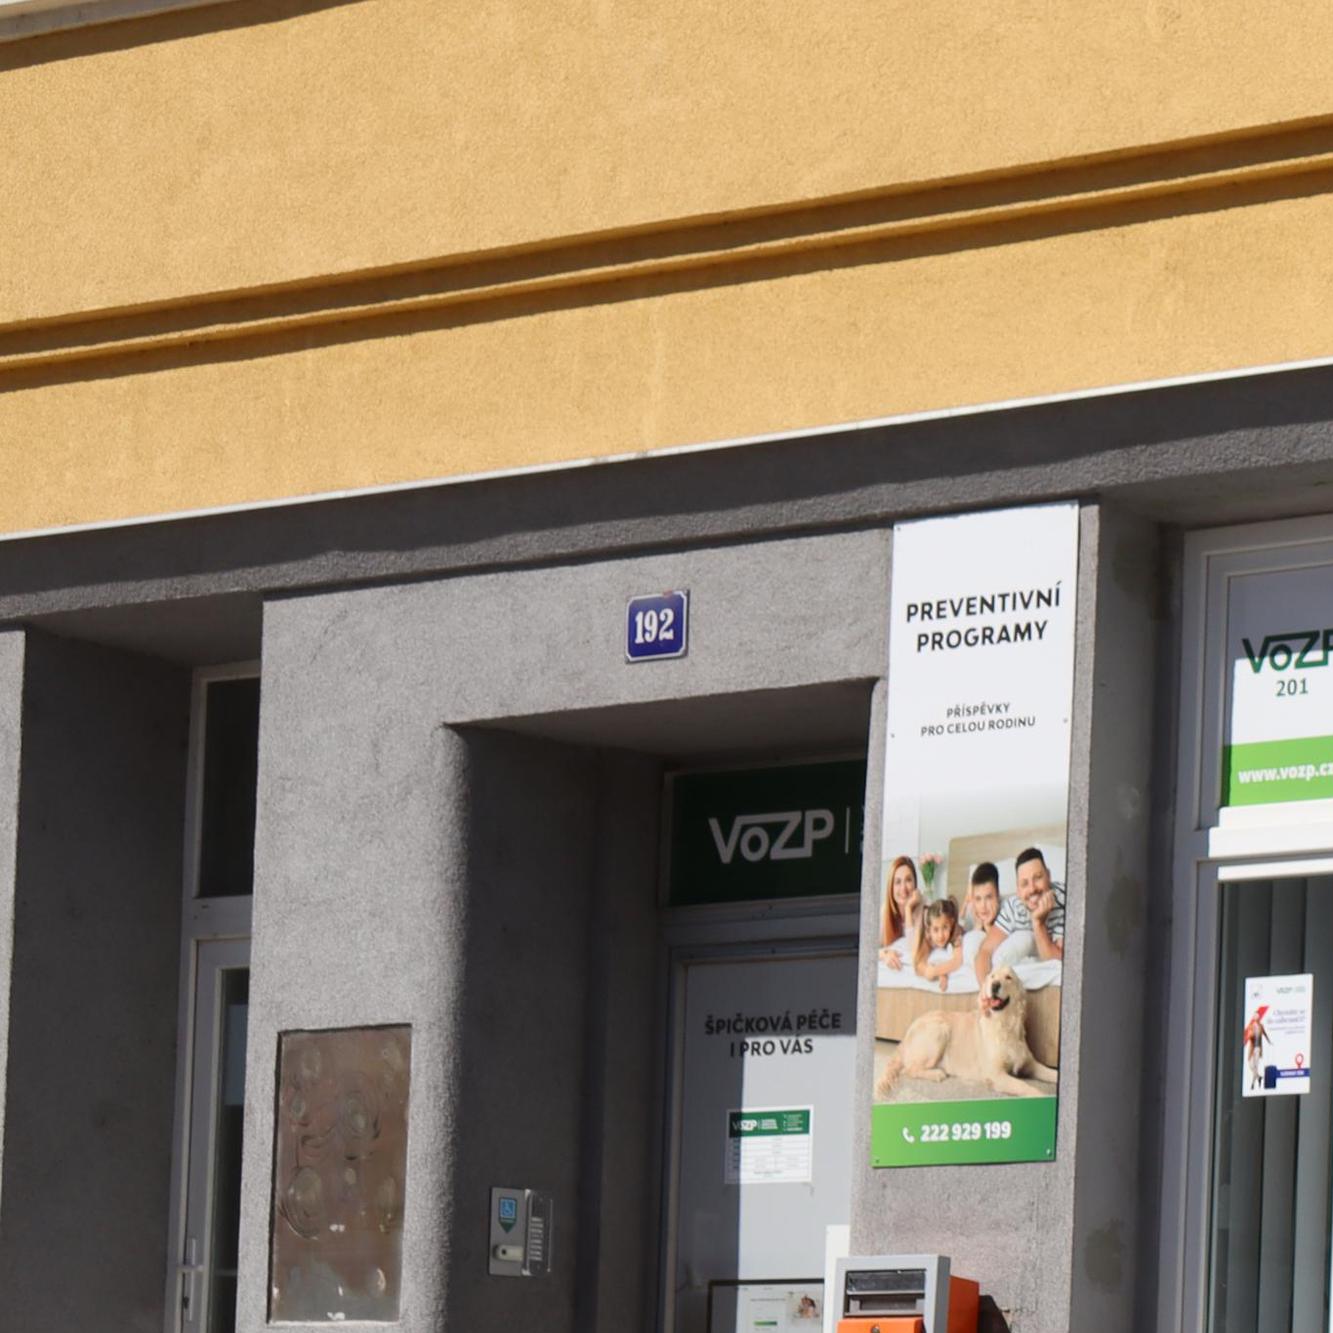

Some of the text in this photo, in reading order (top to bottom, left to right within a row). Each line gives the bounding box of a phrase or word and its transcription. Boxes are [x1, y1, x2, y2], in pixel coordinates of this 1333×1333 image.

[906, 581, 1062, 623] PREVENTIVNÍ
[634, 608, 675, 644] 192
[916, 620, 1049, 652] PROGRAMY
[1276, 678, 1308, 697] 201
[946, 702, 1011, 719] PŘÍSPĚVKY
[921, 716, 1036, 737] PRO CELOU RODINU
[704, 1009, 842, 1035] ŠPIČKOVÁ PÉČE
[738, 1039, 777, 1056] PRO
[779, 1035, 815, 1055] VÁS
[920, 1120, 1012, 1142] 222 929 199
